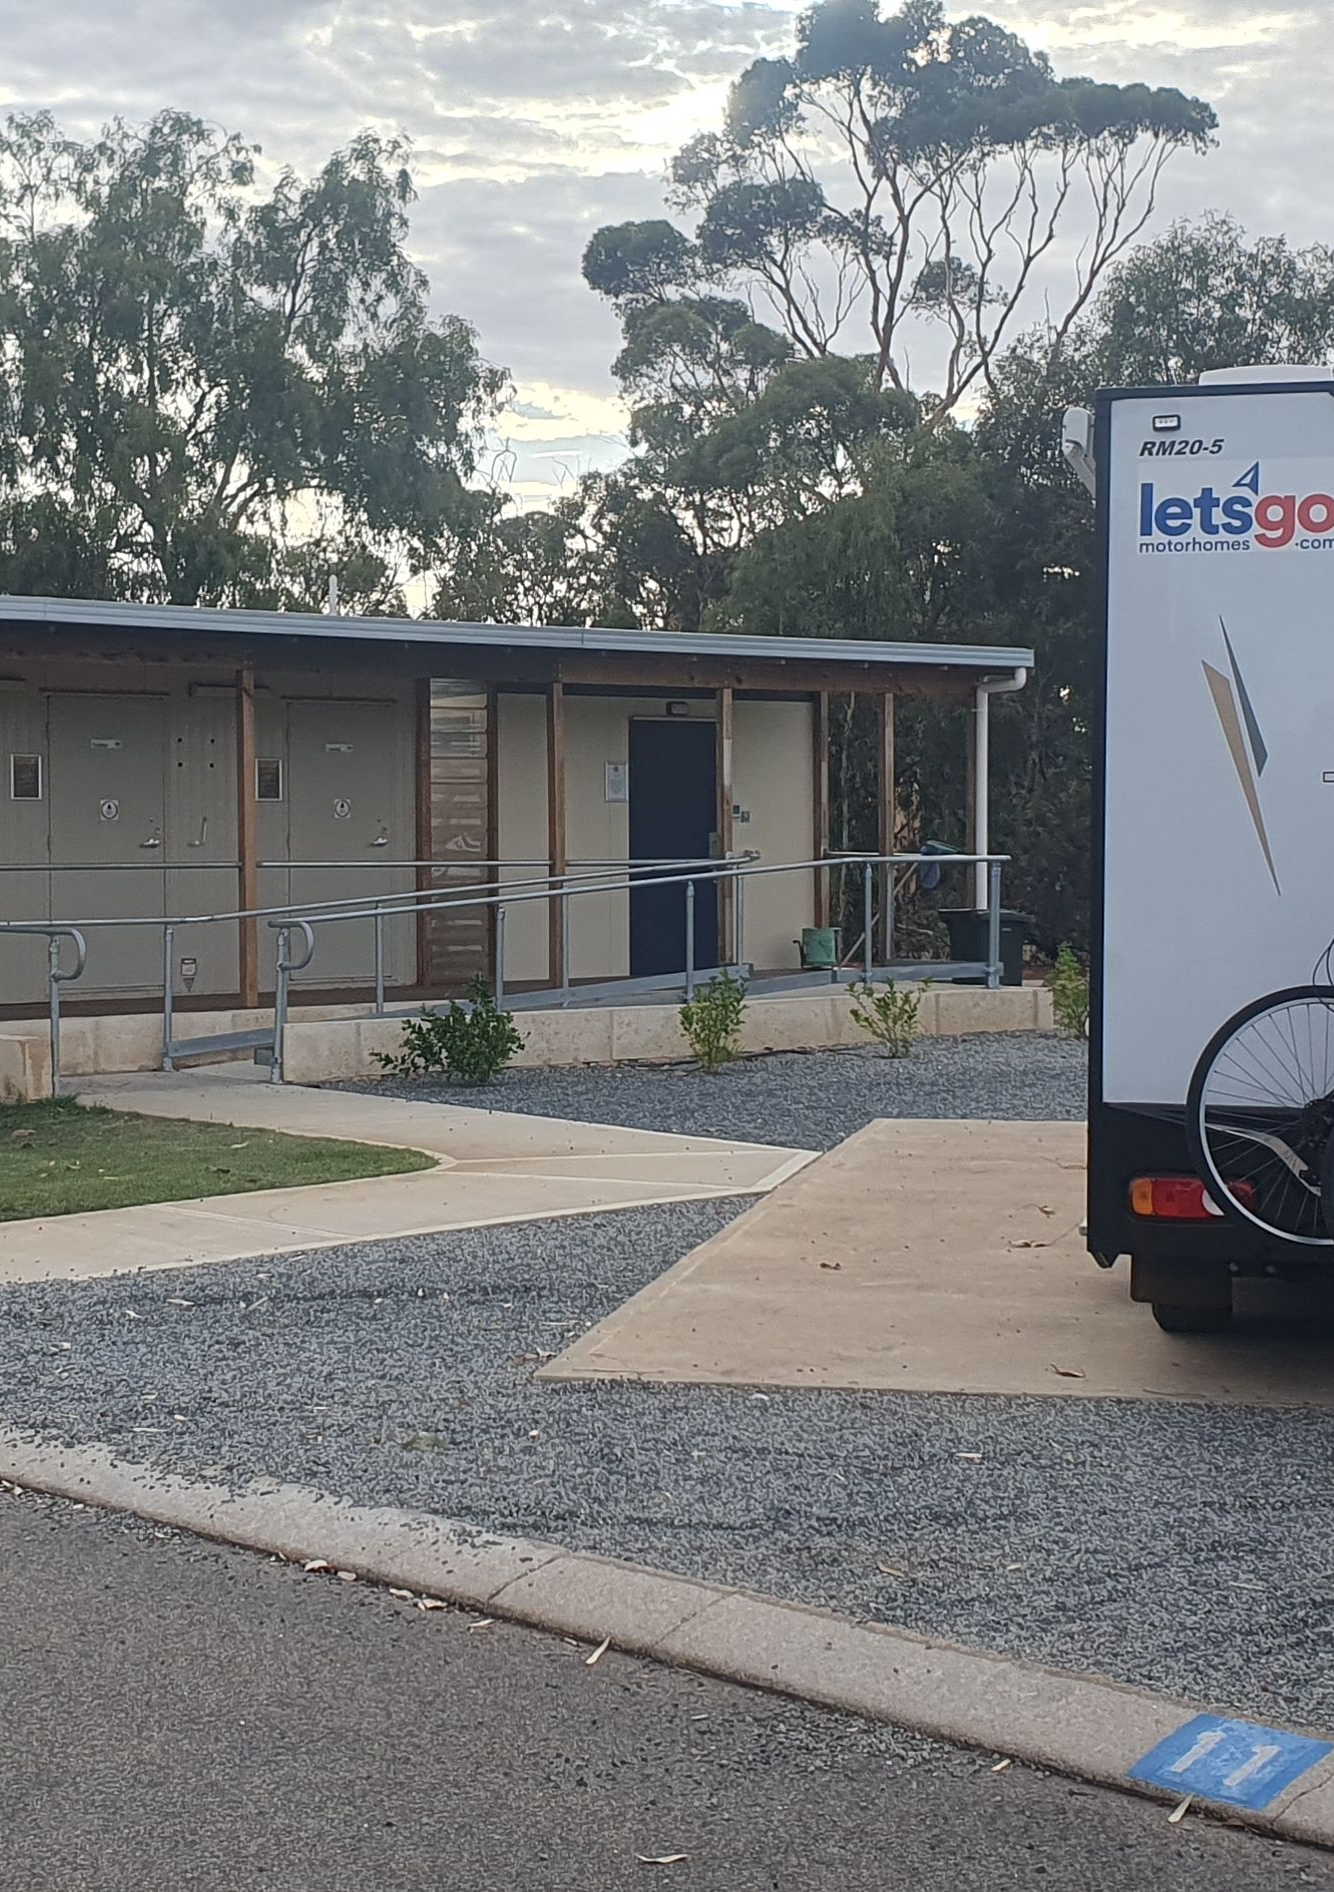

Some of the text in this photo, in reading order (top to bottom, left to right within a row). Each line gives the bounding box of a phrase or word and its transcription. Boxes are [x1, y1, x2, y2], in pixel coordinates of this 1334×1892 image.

[1139, 438, 1225, 457] RM20-5
[1139, 536, 1251, 554] motorhomes
[1170, 1730, 1282, 1788] 11
